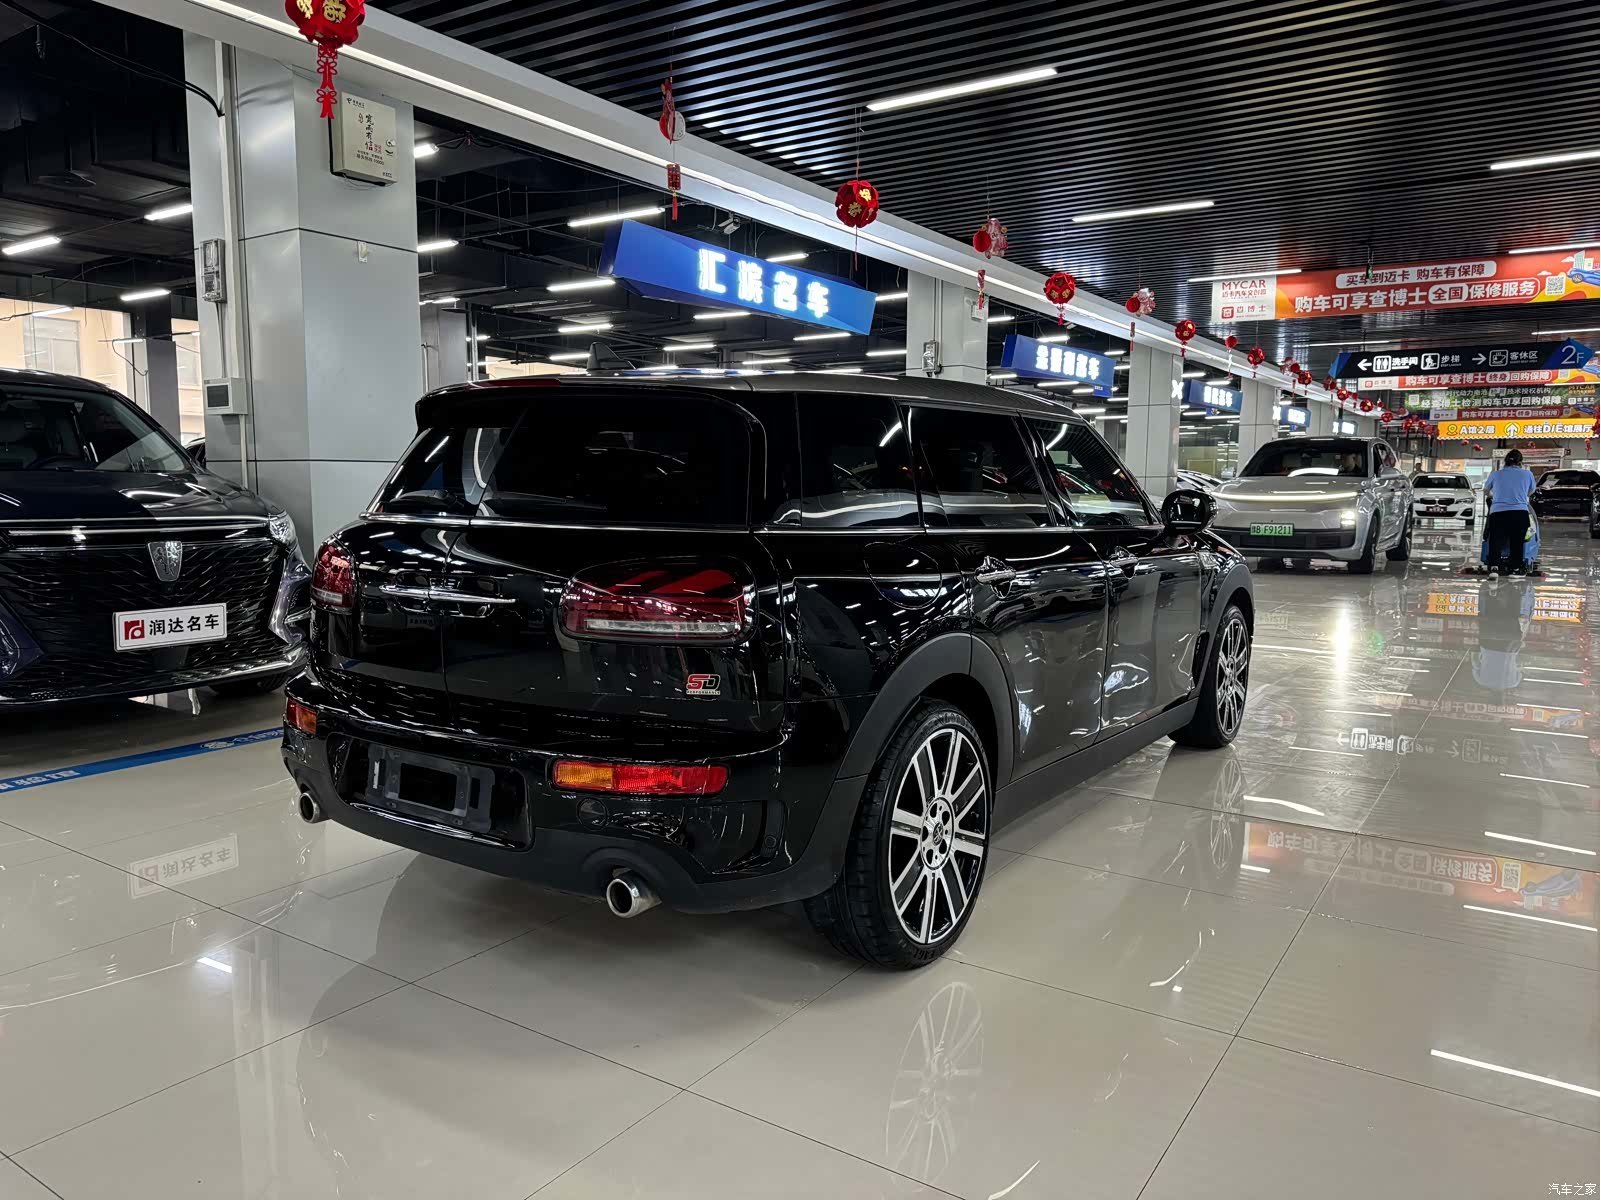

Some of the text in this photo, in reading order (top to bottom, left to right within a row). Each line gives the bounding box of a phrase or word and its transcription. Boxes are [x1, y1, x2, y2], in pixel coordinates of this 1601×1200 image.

[1221, 279, 1266, 291] MYCAR
[1346, 263, 1486, 287] 买车到迈卡 购车有保障
[1295, 280, 1537, 314] 购车可享查博士全国保修服务
[1391, 351, 1539, 367] 洗手间 步梯 客休区
[1561, 345, 1585, 364] 2F
[149, 614, 220, 636] 润达名车
